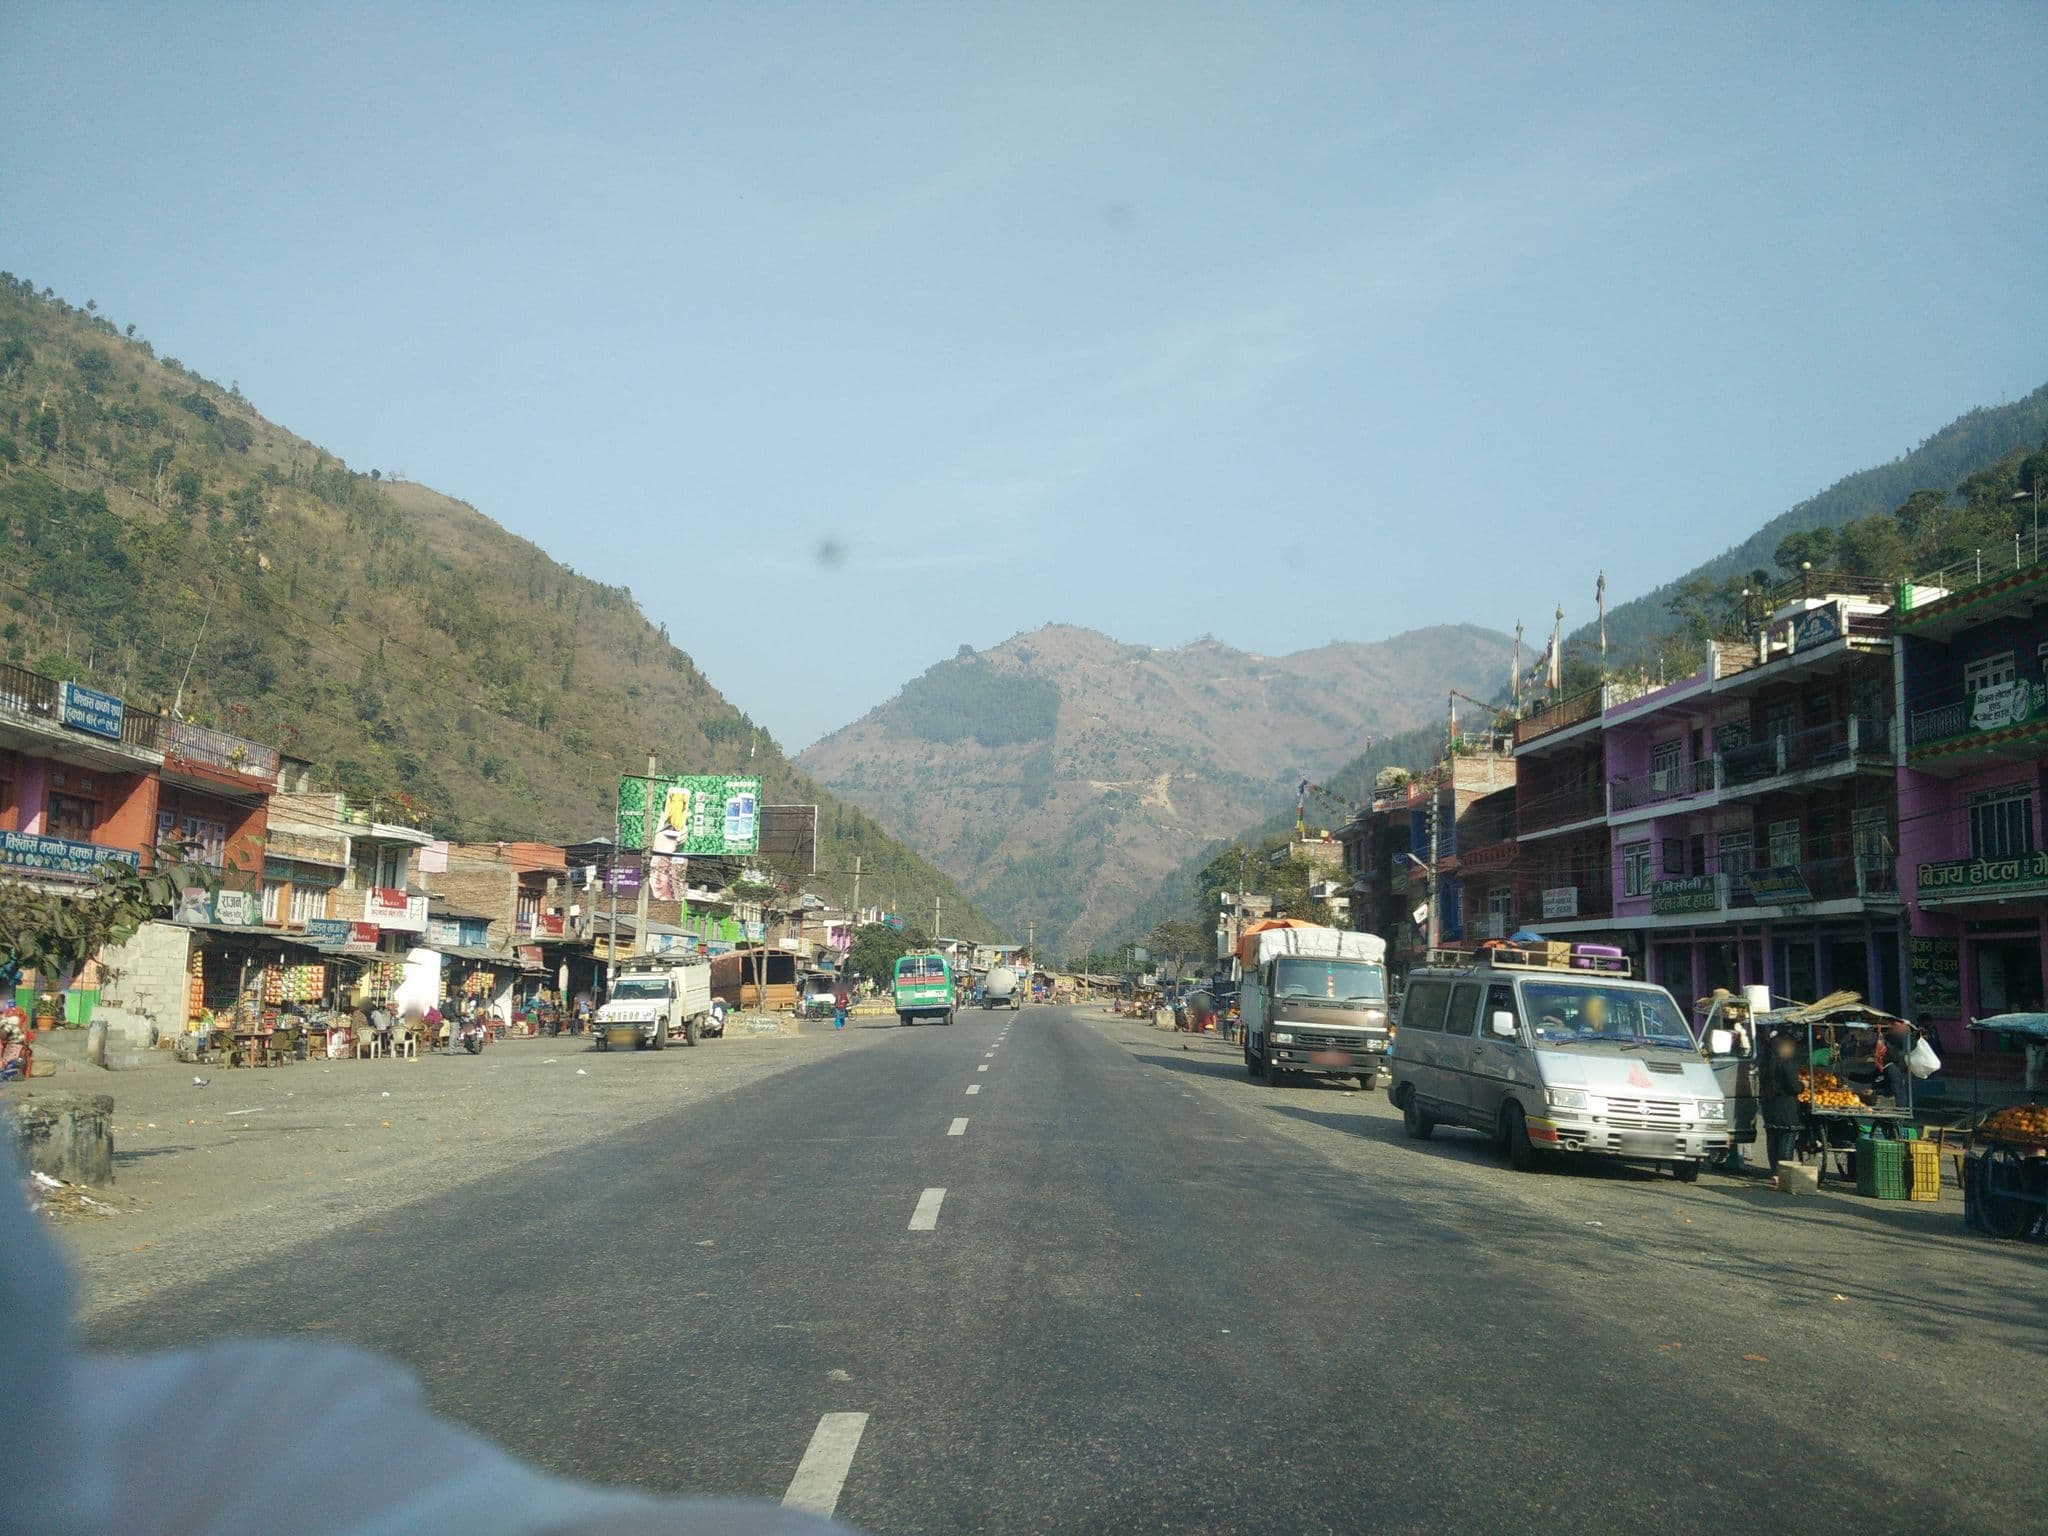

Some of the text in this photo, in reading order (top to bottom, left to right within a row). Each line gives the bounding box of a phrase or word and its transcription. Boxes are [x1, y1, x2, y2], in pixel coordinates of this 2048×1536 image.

[6, 832, 38, 852] विश्वास
[1918, 863, 1964, 887] बिजय
[1968, 858, 2021, 885] होटल
